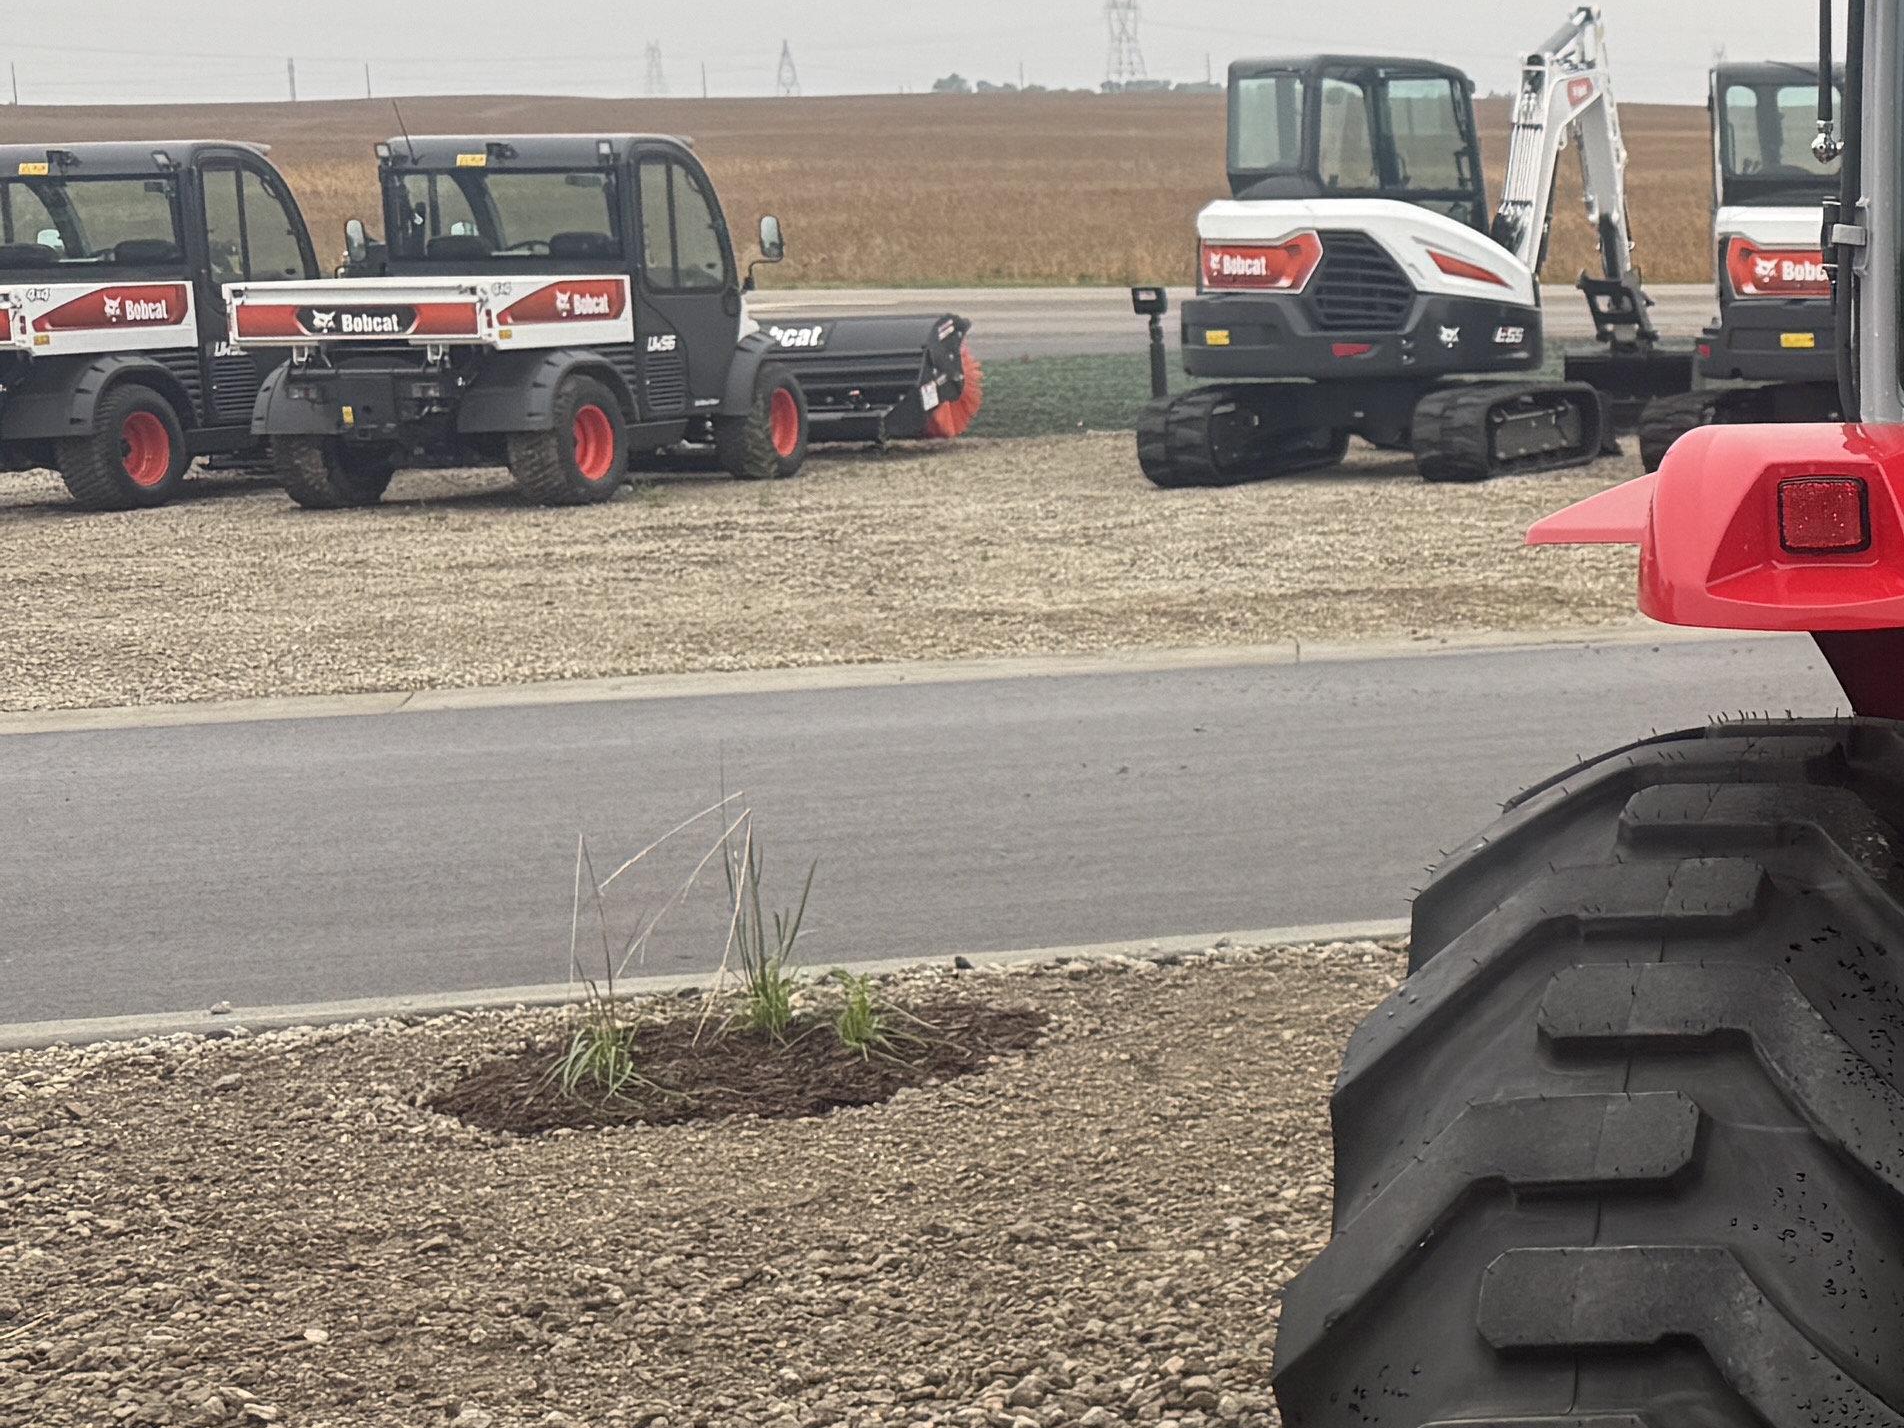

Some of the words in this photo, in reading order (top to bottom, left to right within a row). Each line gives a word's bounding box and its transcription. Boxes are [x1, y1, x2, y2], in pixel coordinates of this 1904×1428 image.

[1222, 254, 1267, 276] Bobcat
[1782, 260, 1830, 282] Bobc
[125, 299, 168, 321] Bobcat
[573, 292, 610, 315] Bobcat
[341, 313, 400, 333] Bobcat
